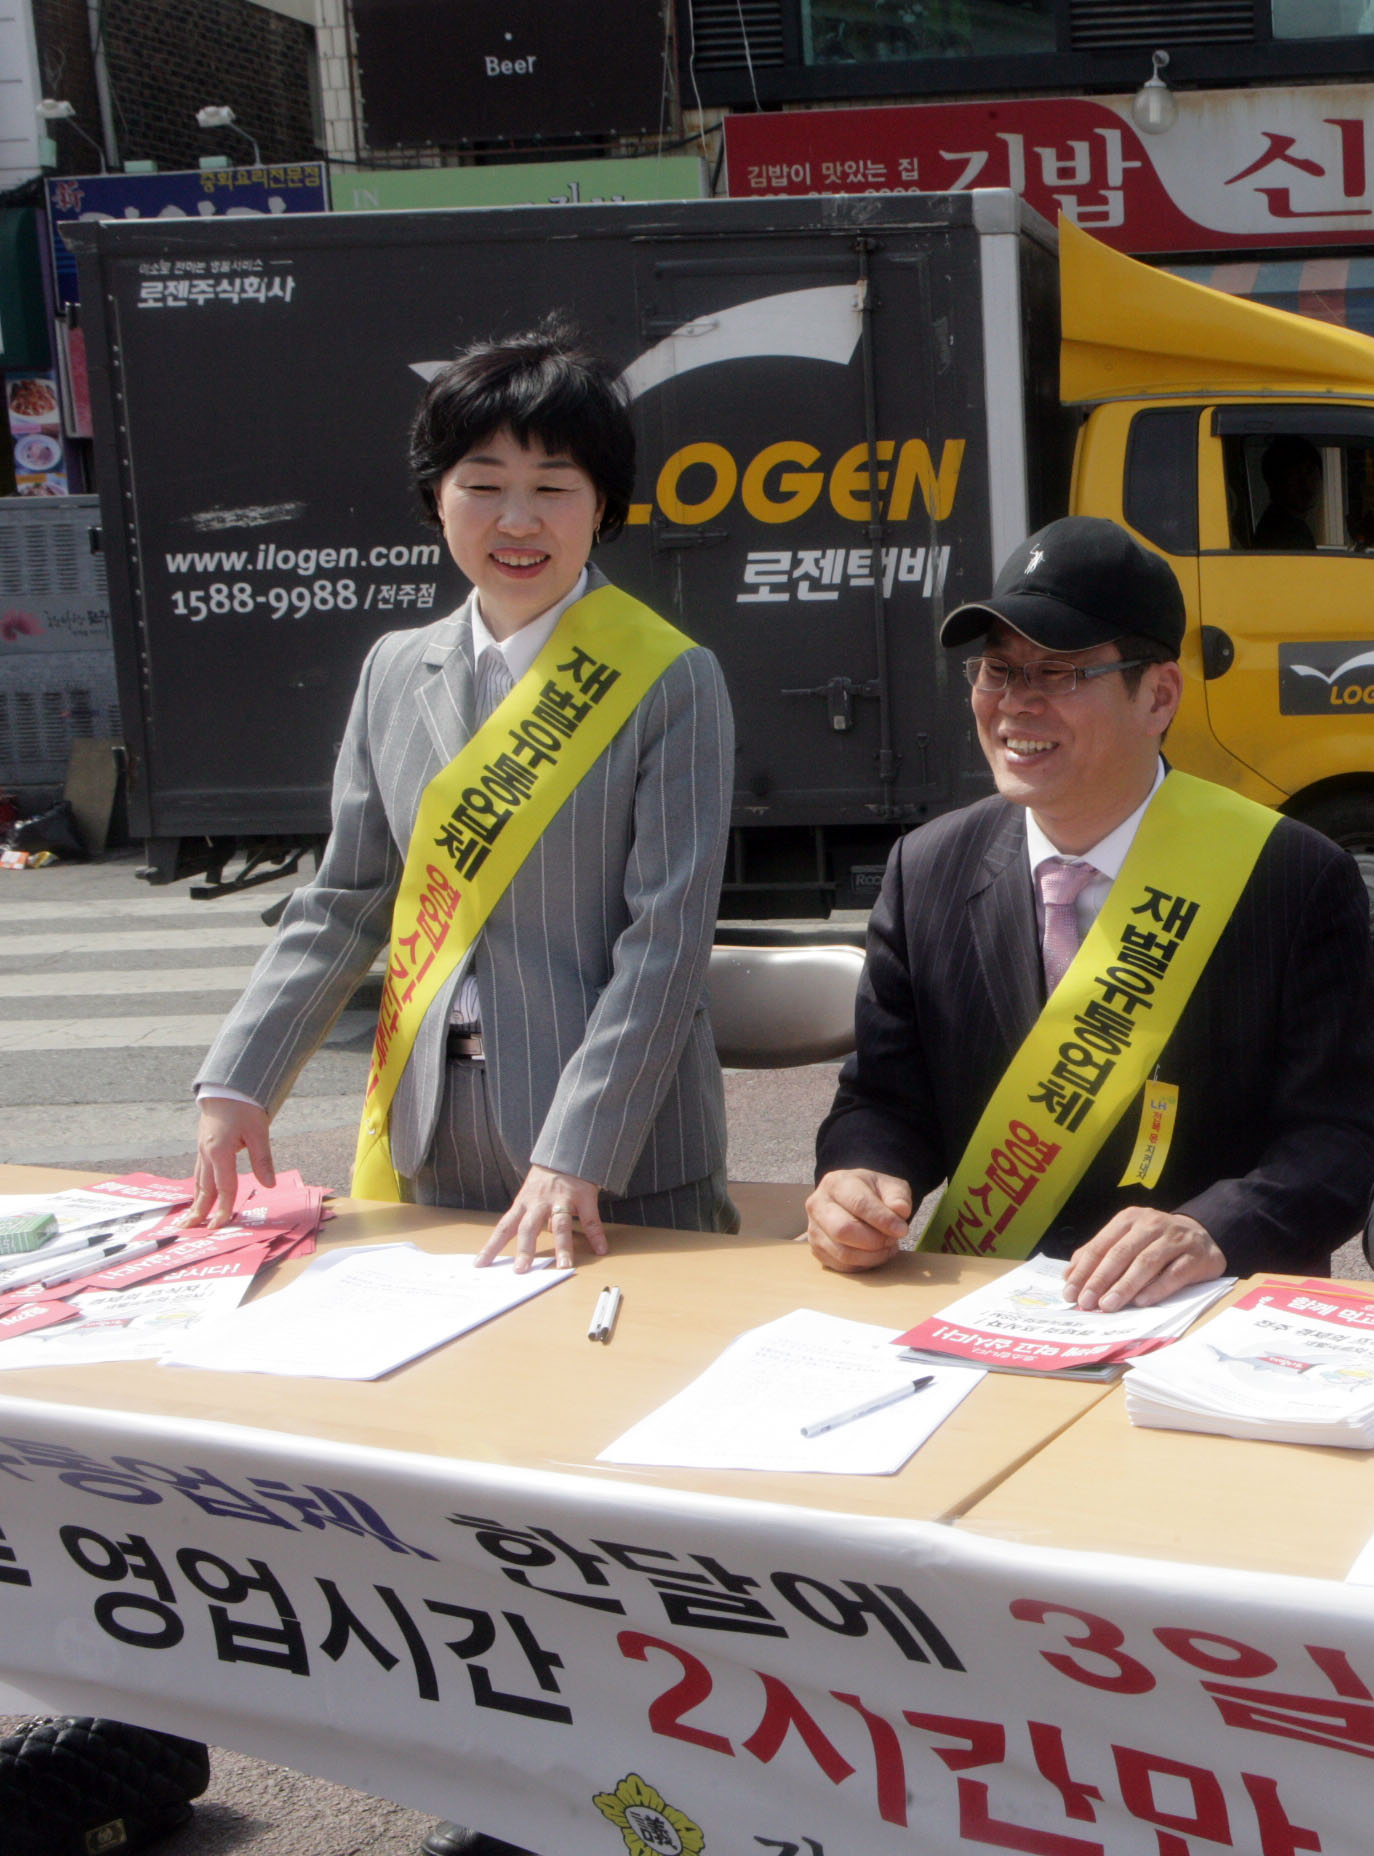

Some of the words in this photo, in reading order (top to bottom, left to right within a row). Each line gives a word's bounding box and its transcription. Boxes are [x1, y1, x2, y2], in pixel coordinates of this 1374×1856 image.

[485, 54, 537, 77] Beer
[747, 162, 811, 188] 김밥이
[821, 159, 887, 186] 맛있는
[898, 158, 919, 181] 집
[137, 275, 296, 309] 로젠주식회사
[165, 543, 441, 576] www.ilogen.com
[735, 545, 951, 603] 로젠택배
[171, 579, 358, 622] 1588-9988
[434, 646, 622, 883] 재벌유통업체
[1027, 885, 1200, 1133] 재벌유통업체
[445, 1512, 967, 1672] 한달에
[58, 1525, 574, 1725] 영업시간
